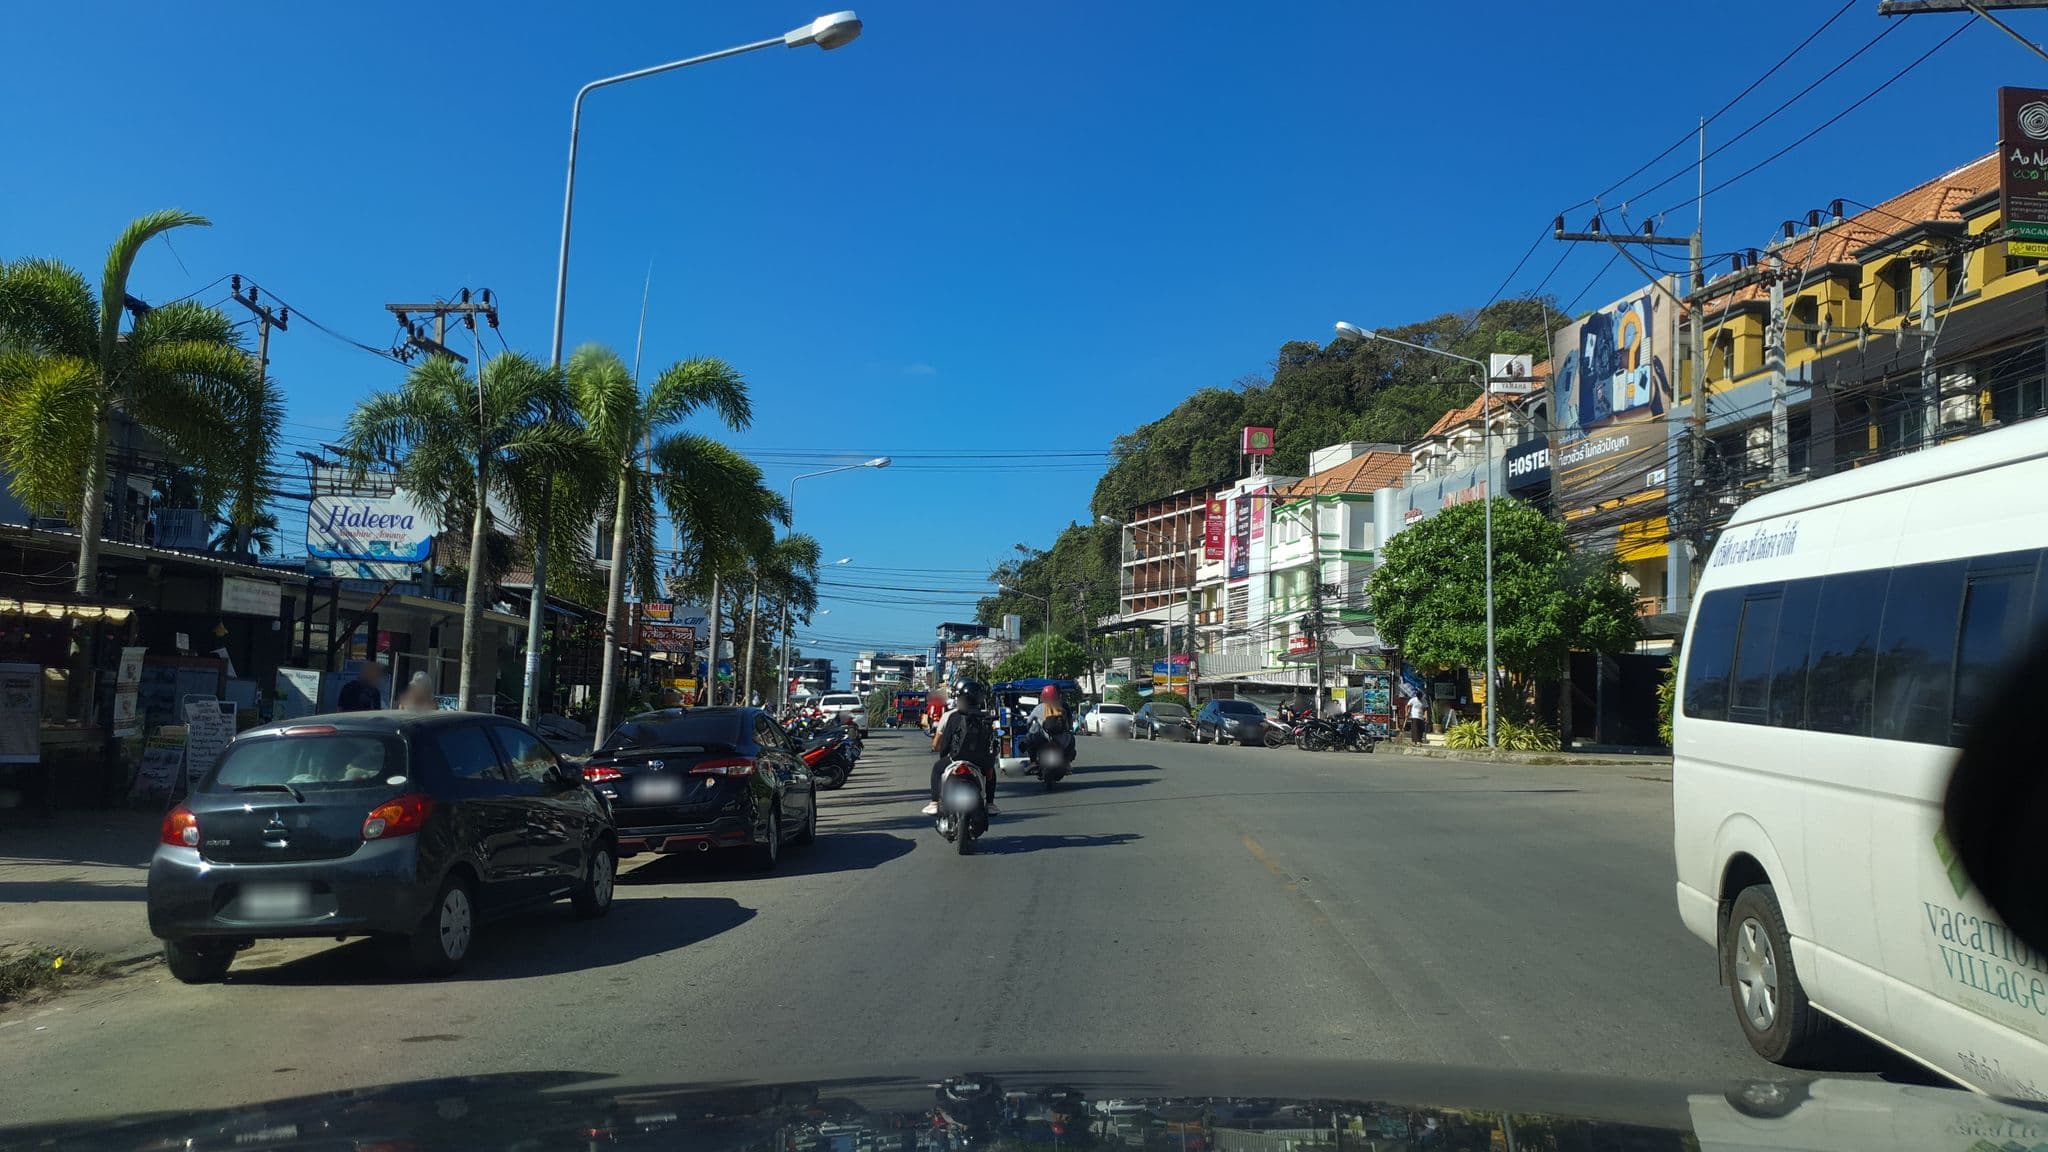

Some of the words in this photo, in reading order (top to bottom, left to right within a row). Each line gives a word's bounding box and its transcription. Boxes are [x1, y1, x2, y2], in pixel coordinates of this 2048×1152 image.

[2010, 148, 2030, 166] Ao
[2012, 169, 2039, 180] eco
[1508, 448, 1550, 478] HOSTEL
[319, 505, 414, 533] Haleeva
